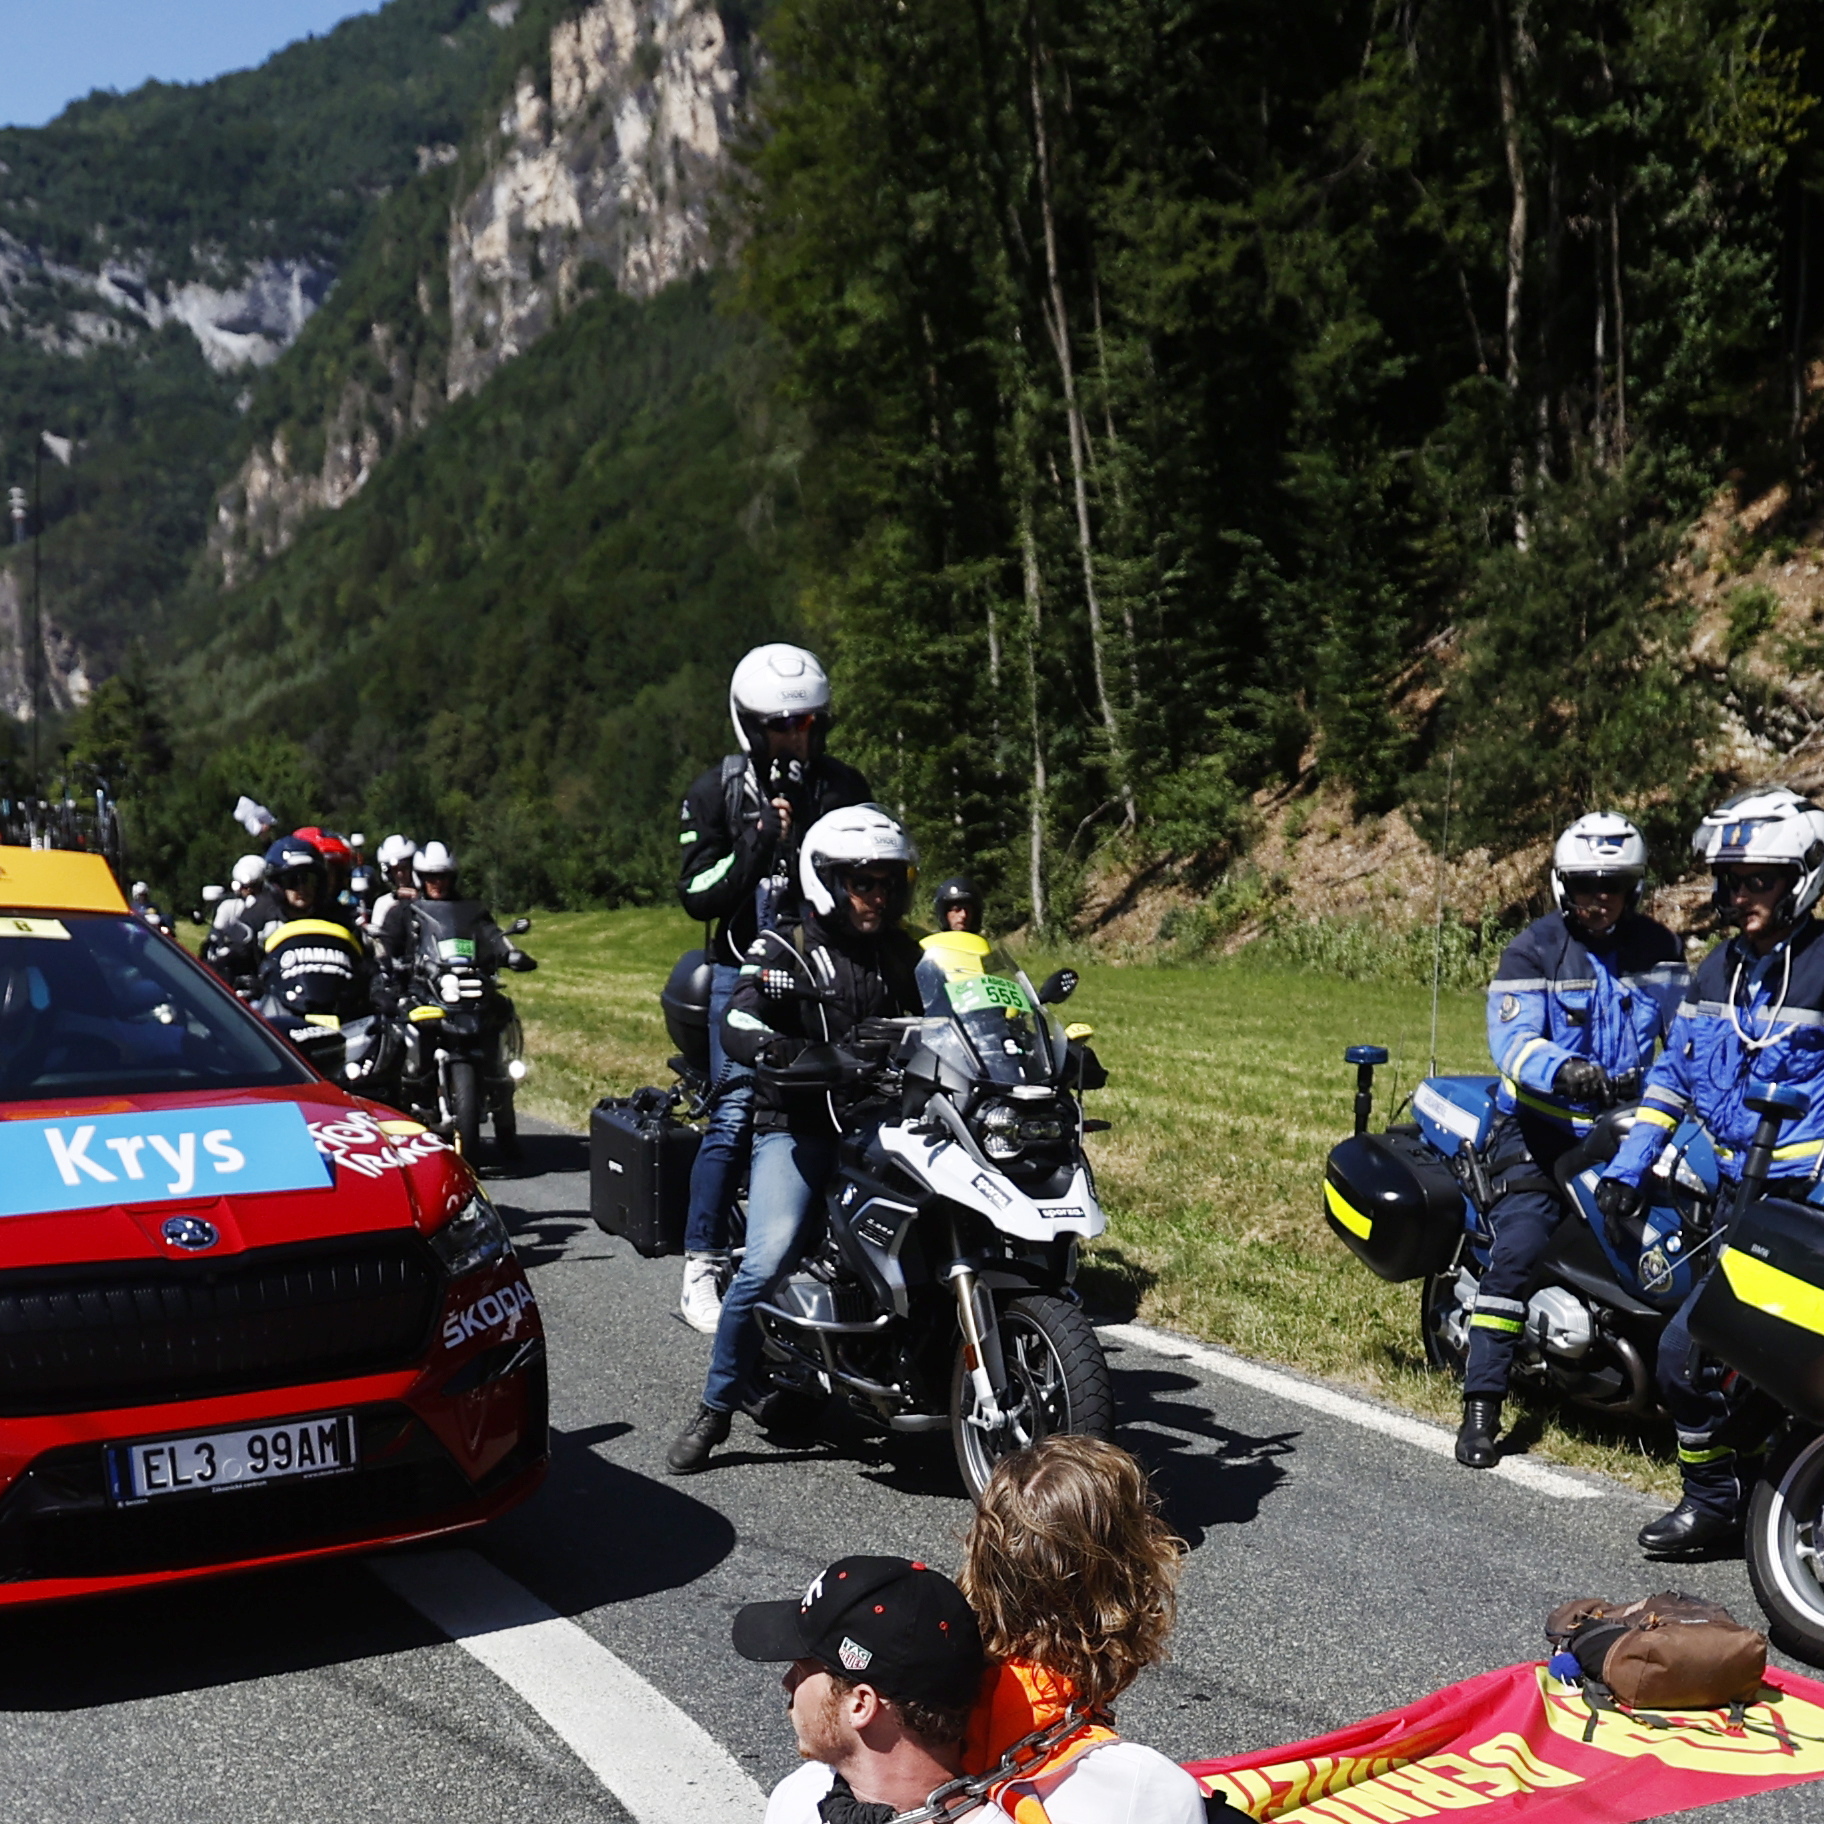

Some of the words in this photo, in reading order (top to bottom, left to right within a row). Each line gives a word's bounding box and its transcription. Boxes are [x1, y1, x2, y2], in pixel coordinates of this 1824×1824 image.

[986, 986, 1023, 1008] 555
[43, 1124, 245, 1195] Krys
[1750, 1243, 1771, 1259] BMW
[442, 1280, 535, 1350] ŠKODA
[142, 1441, 217, 1491] EL3
[247, 1422, 341, 1475] 99AM
[845, 1640, 869, 1661] TAG
